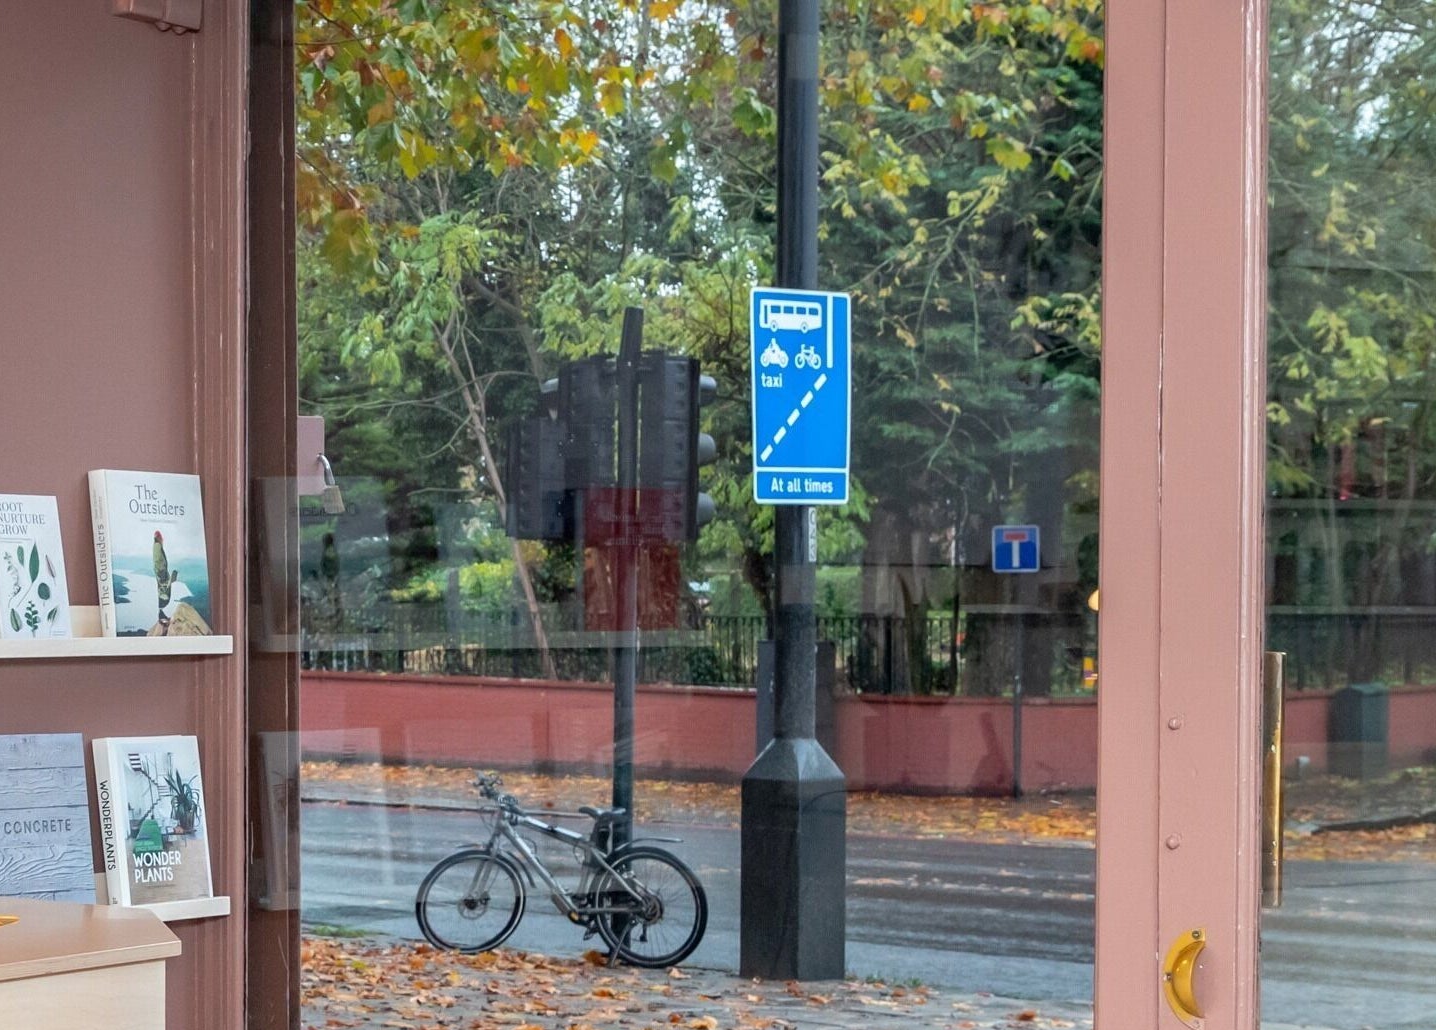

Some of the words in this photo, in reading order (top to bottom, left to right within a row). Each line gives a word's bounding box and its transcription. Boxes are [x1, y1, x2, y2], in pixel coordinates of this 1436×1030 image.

[761, 373, 783, 388] taxi
[134, 484, 158, 500] The
[771, 477, 783, 493] At
[787, 478, 801, 493] all
[804, 478, 833, 494] times
[129, 499, 185, 516] Outsiders
[97, 524, 109, 582] Outsiders
[101, 586, 110, 608] The
[4, 818, 72, 834] CONCRETE
[99, 780, 116, 870] WONDERPLANTS
[133, 851, 182, 867] WONDER
[134, 866, 174, 883] PLANTS
